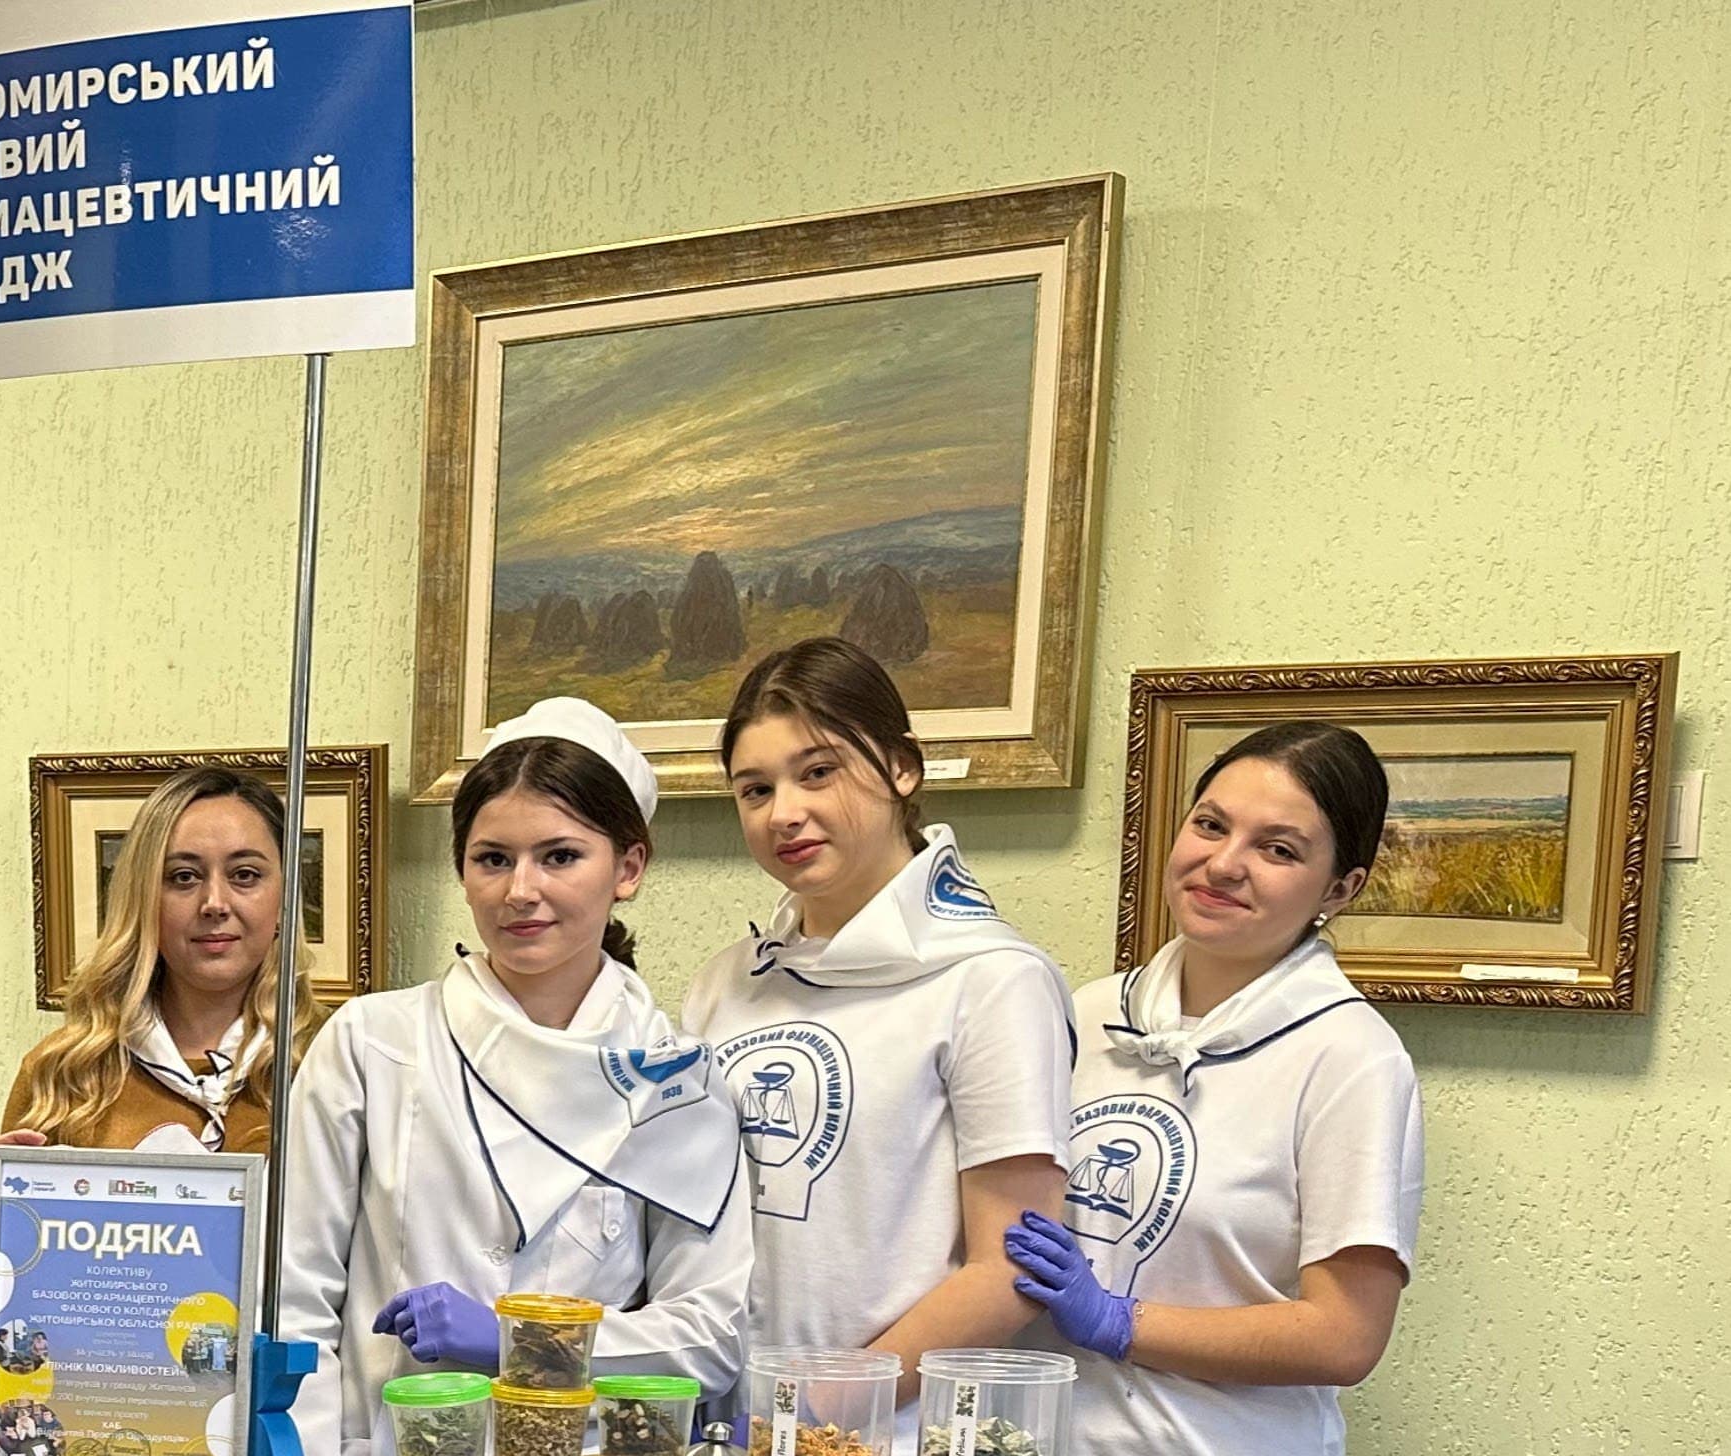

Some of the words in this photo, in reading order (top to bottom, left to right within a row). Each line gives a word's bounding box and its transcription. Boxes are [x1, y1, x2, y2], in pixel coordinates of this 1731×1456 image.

[725, 1030, 785, 1058] БАЗОВИЙ
[785, 1030, 845, 1110] ФАРМАЦЕВТИЧНИЙ
[803, 1113, 841, 1171] КОЛЕДЖ
[1075, 1101, 1137, 1125] БАЗОВИЙ
[1132, 1197, 1174, 1253] КОЛЕДЖ
[41, 1218, 204, 1261] ПОДЯКА
[32, 1289, 91, 1301] БАЗОВОГО
[70, 1279, 168, 1292] ЖИТОМИРСЬКОГО
[60, 1304, 122, 1316] ФАХОВОГО
